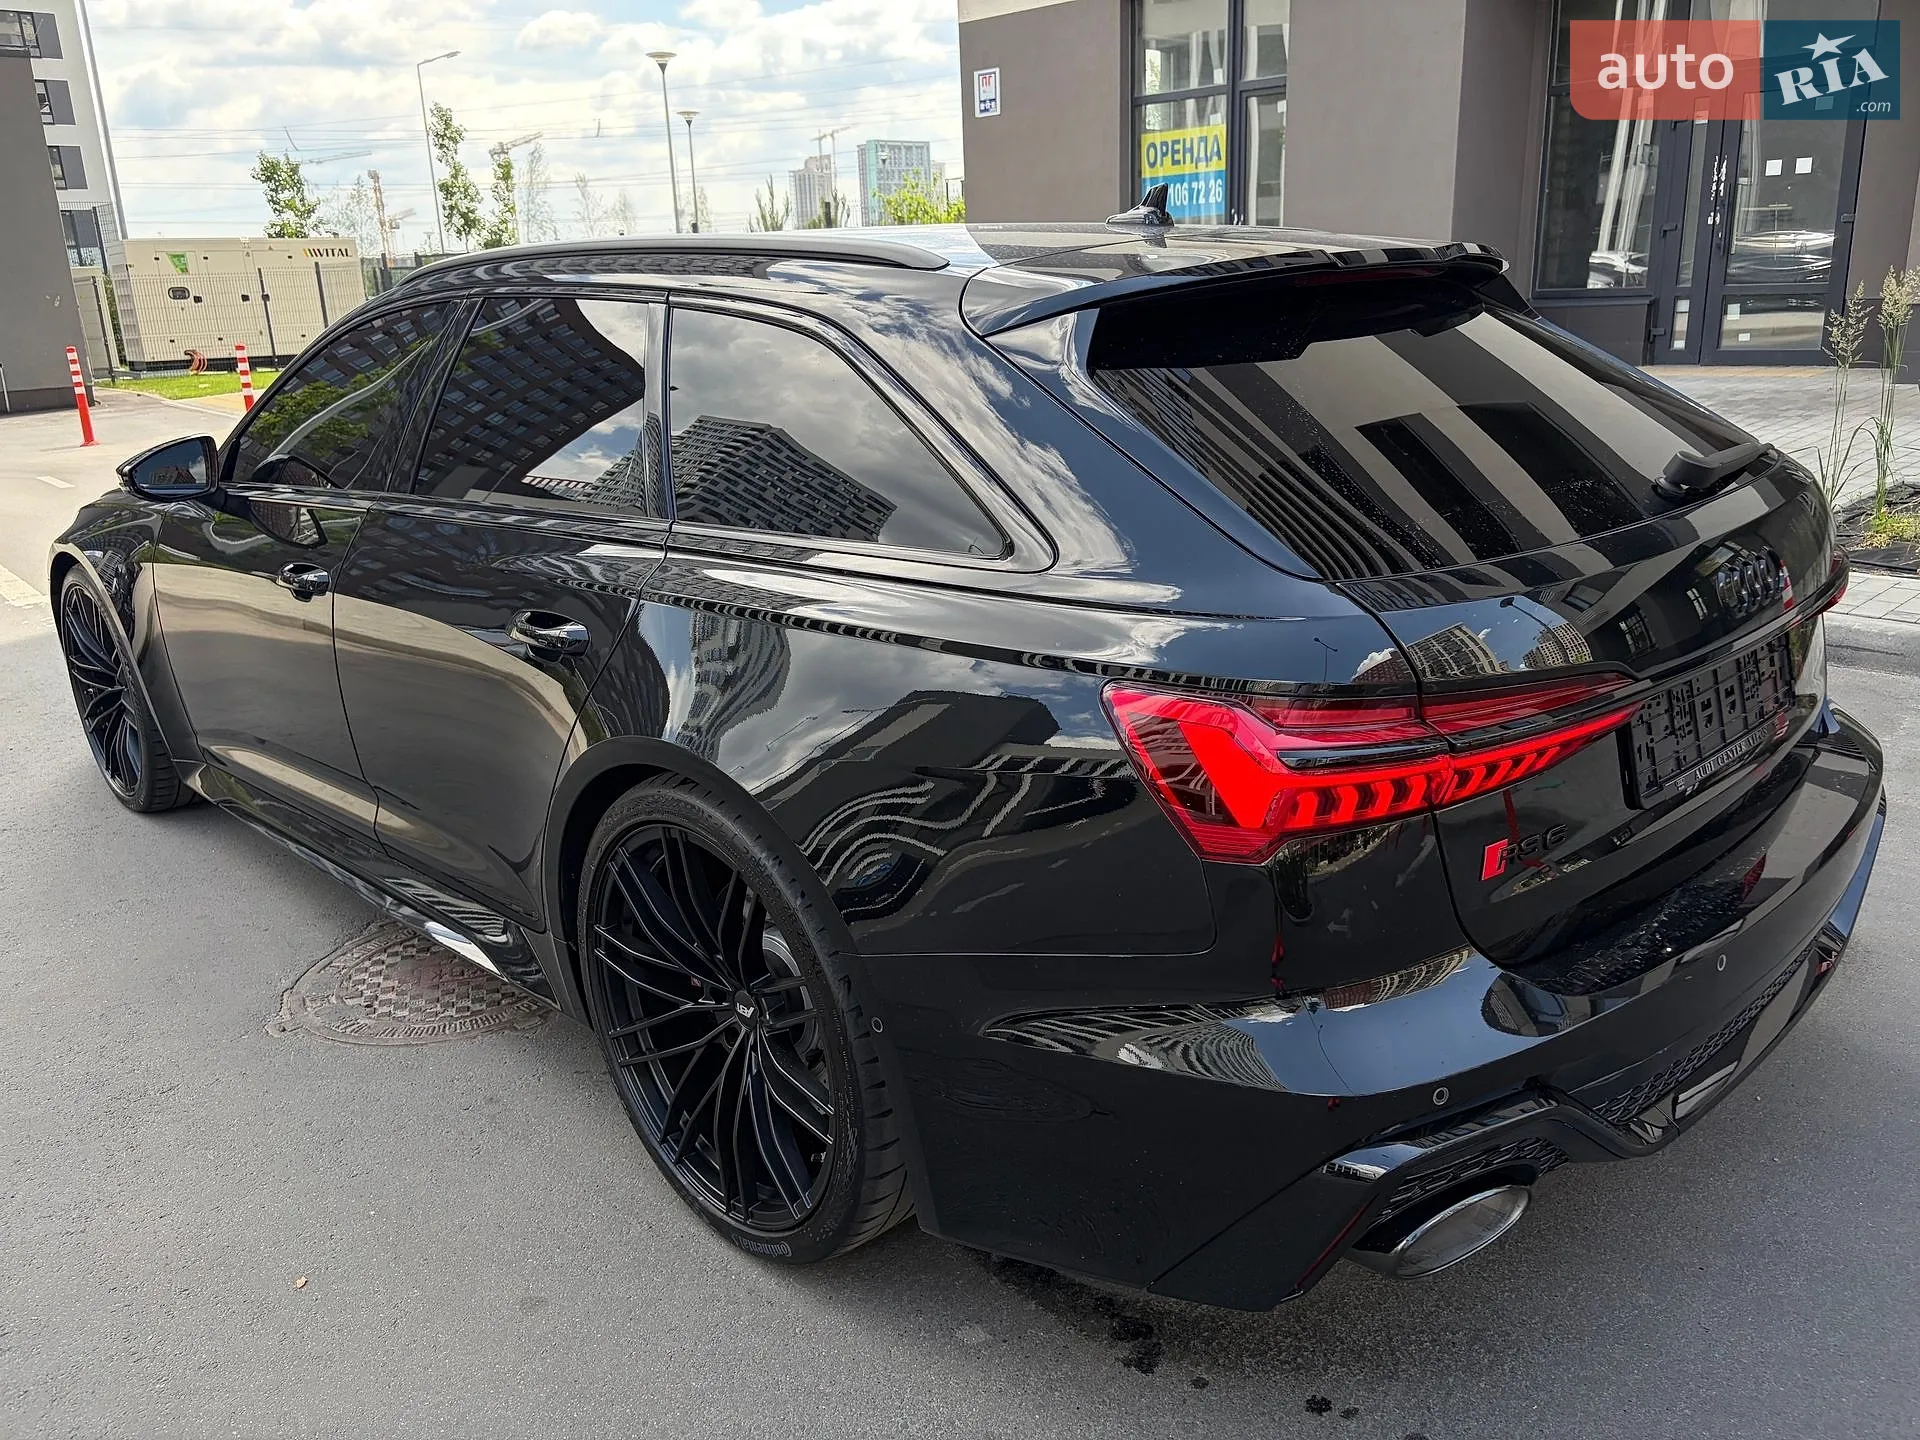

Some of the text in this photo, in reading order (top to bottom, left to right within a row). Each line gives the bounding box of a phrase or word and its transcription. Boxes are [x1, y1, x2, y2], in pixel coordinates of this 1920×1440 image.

[1146, 133, 1222, 169] ОРЕНДА
[1191, 180, 1206, 205] 72
[1208, 178, 1223, 204] 26
[316, 248, 353, 257] VITAL
[1694, 760, 1716, 782] AUDI
[1716, 743, 1746, 766] CENTER
[1483, 824, 1567, 880] RS6
[738, 1235, 792, 1258] Continental
